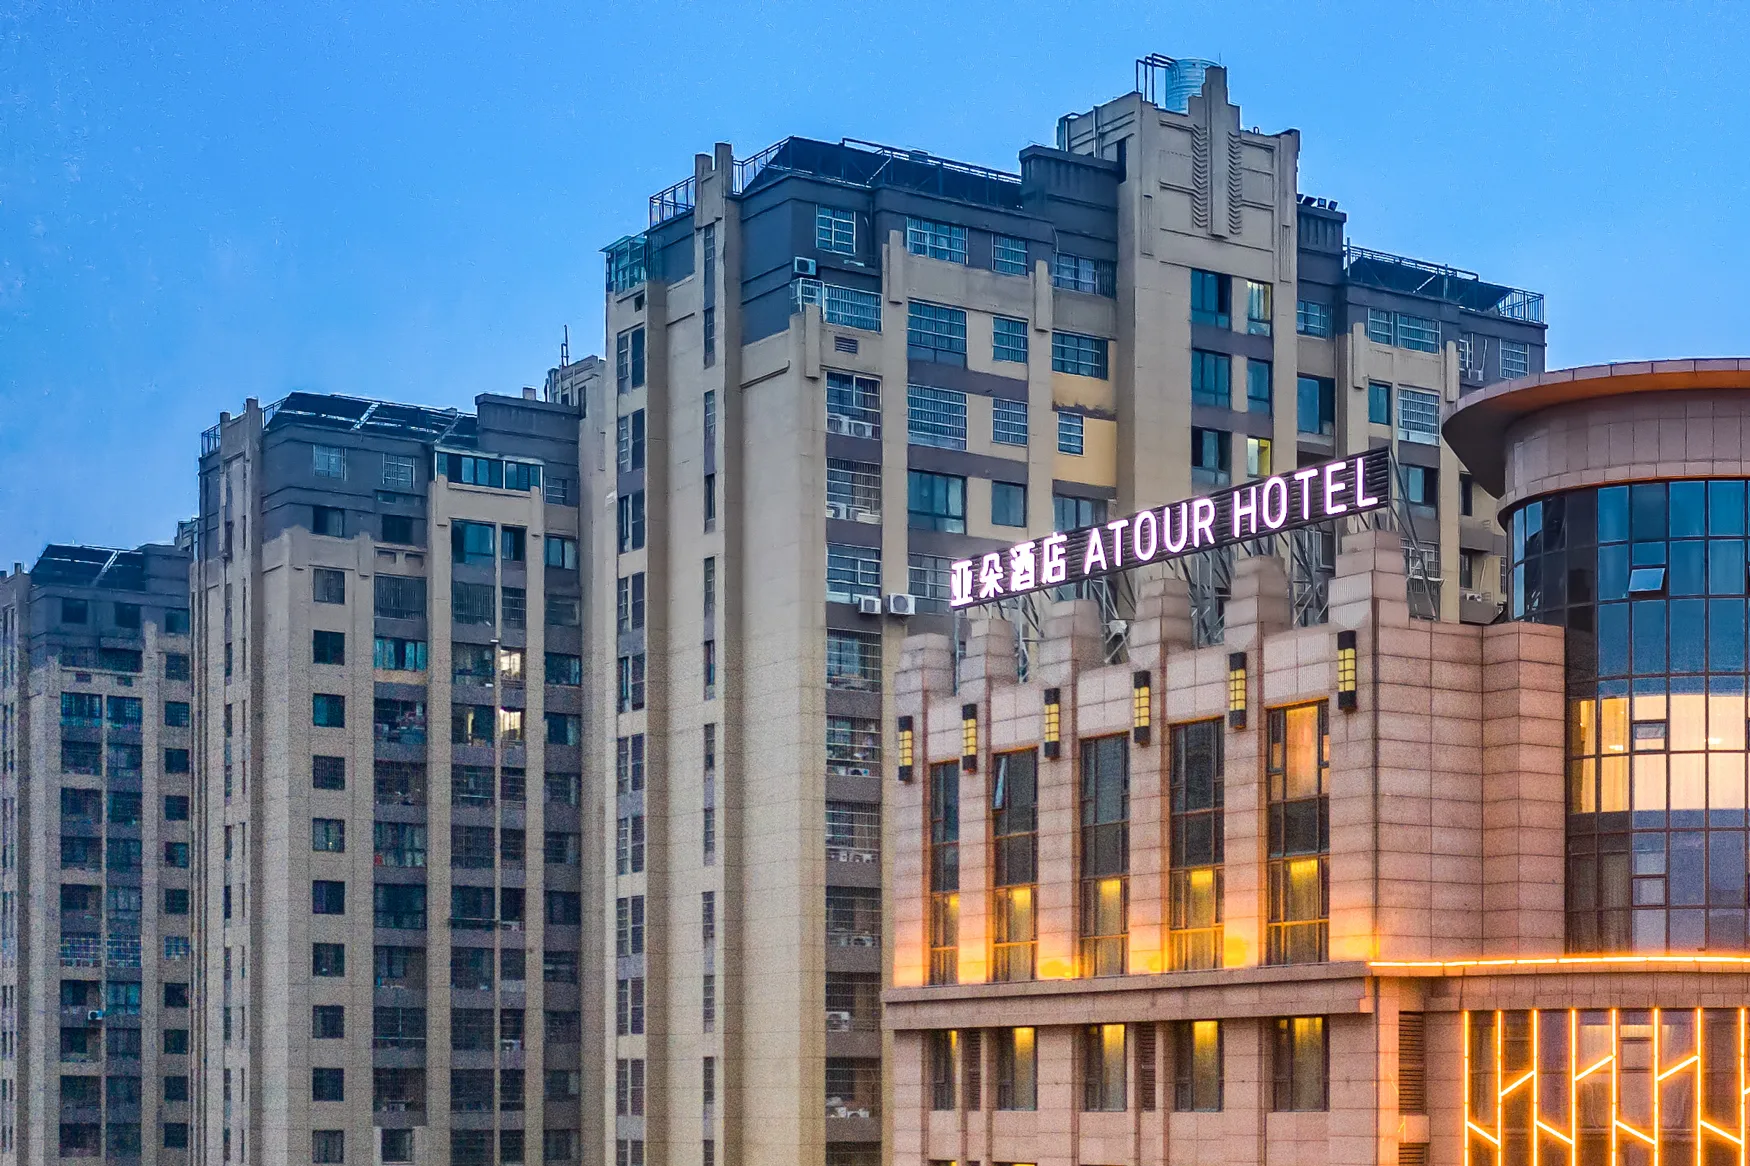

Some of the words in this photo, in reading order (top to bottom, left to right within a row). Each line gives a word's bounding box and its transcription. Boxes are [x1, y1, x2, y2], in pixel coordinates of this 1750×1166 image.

[950, 532, 1067, 606] 亚朵酒店
[1084, 498, 1215, 575] ATOUR
[1233, 457, 1378, 538] HOTEL
